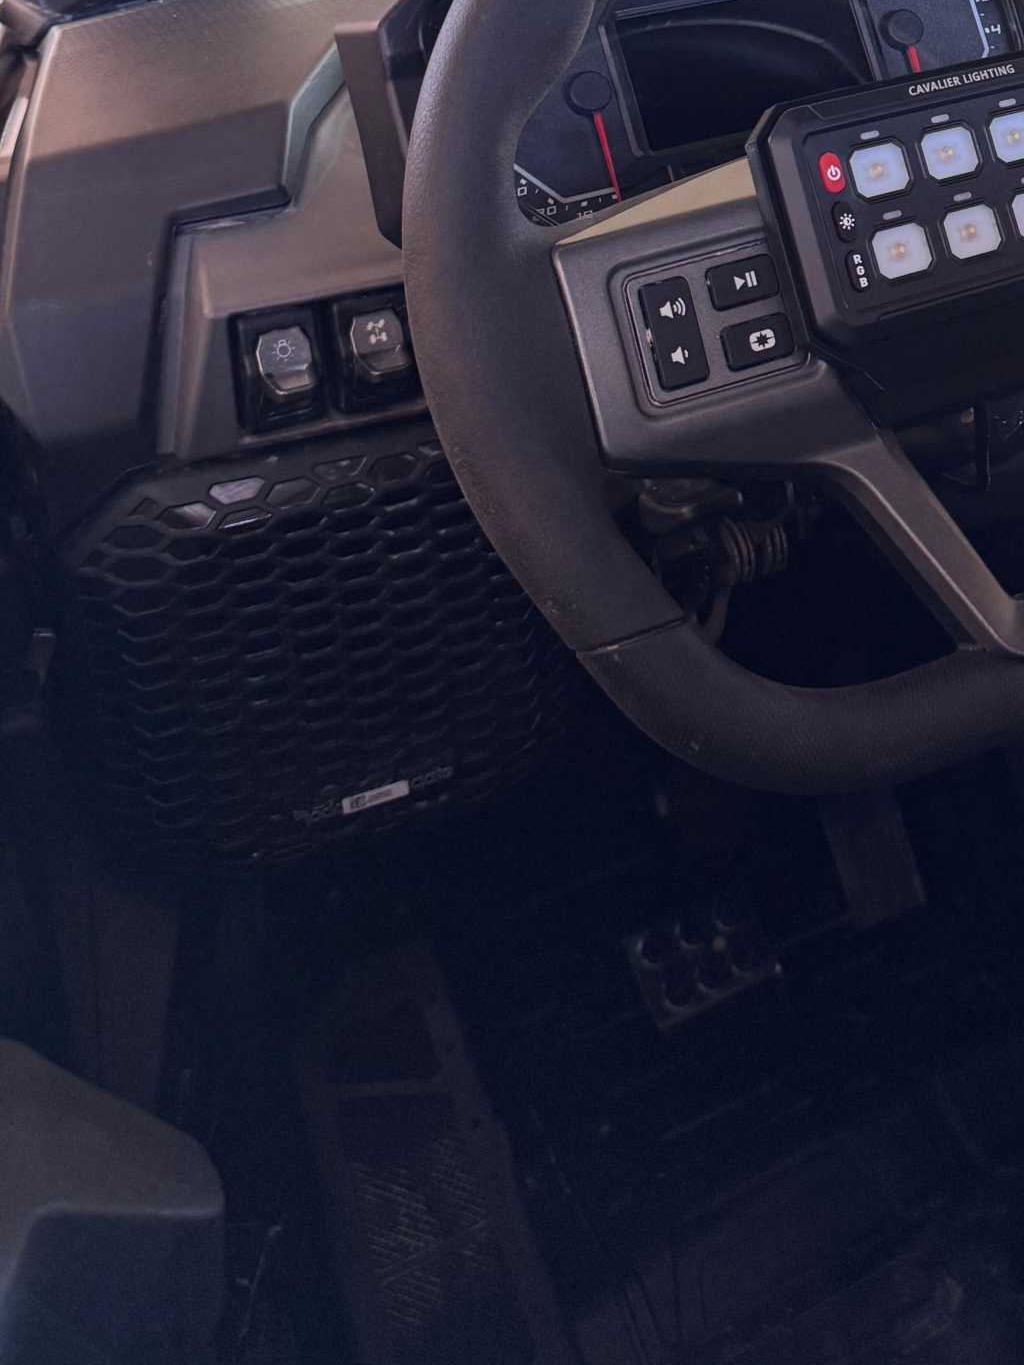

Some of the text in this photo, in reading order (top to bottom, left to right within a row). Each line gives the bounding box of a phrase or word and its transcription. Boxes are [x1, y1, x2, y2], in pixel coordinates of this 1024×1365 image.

[991, 24, 1001, 35] 4
[908, 64, 1016, 96] CAVALIER LIGHTING
